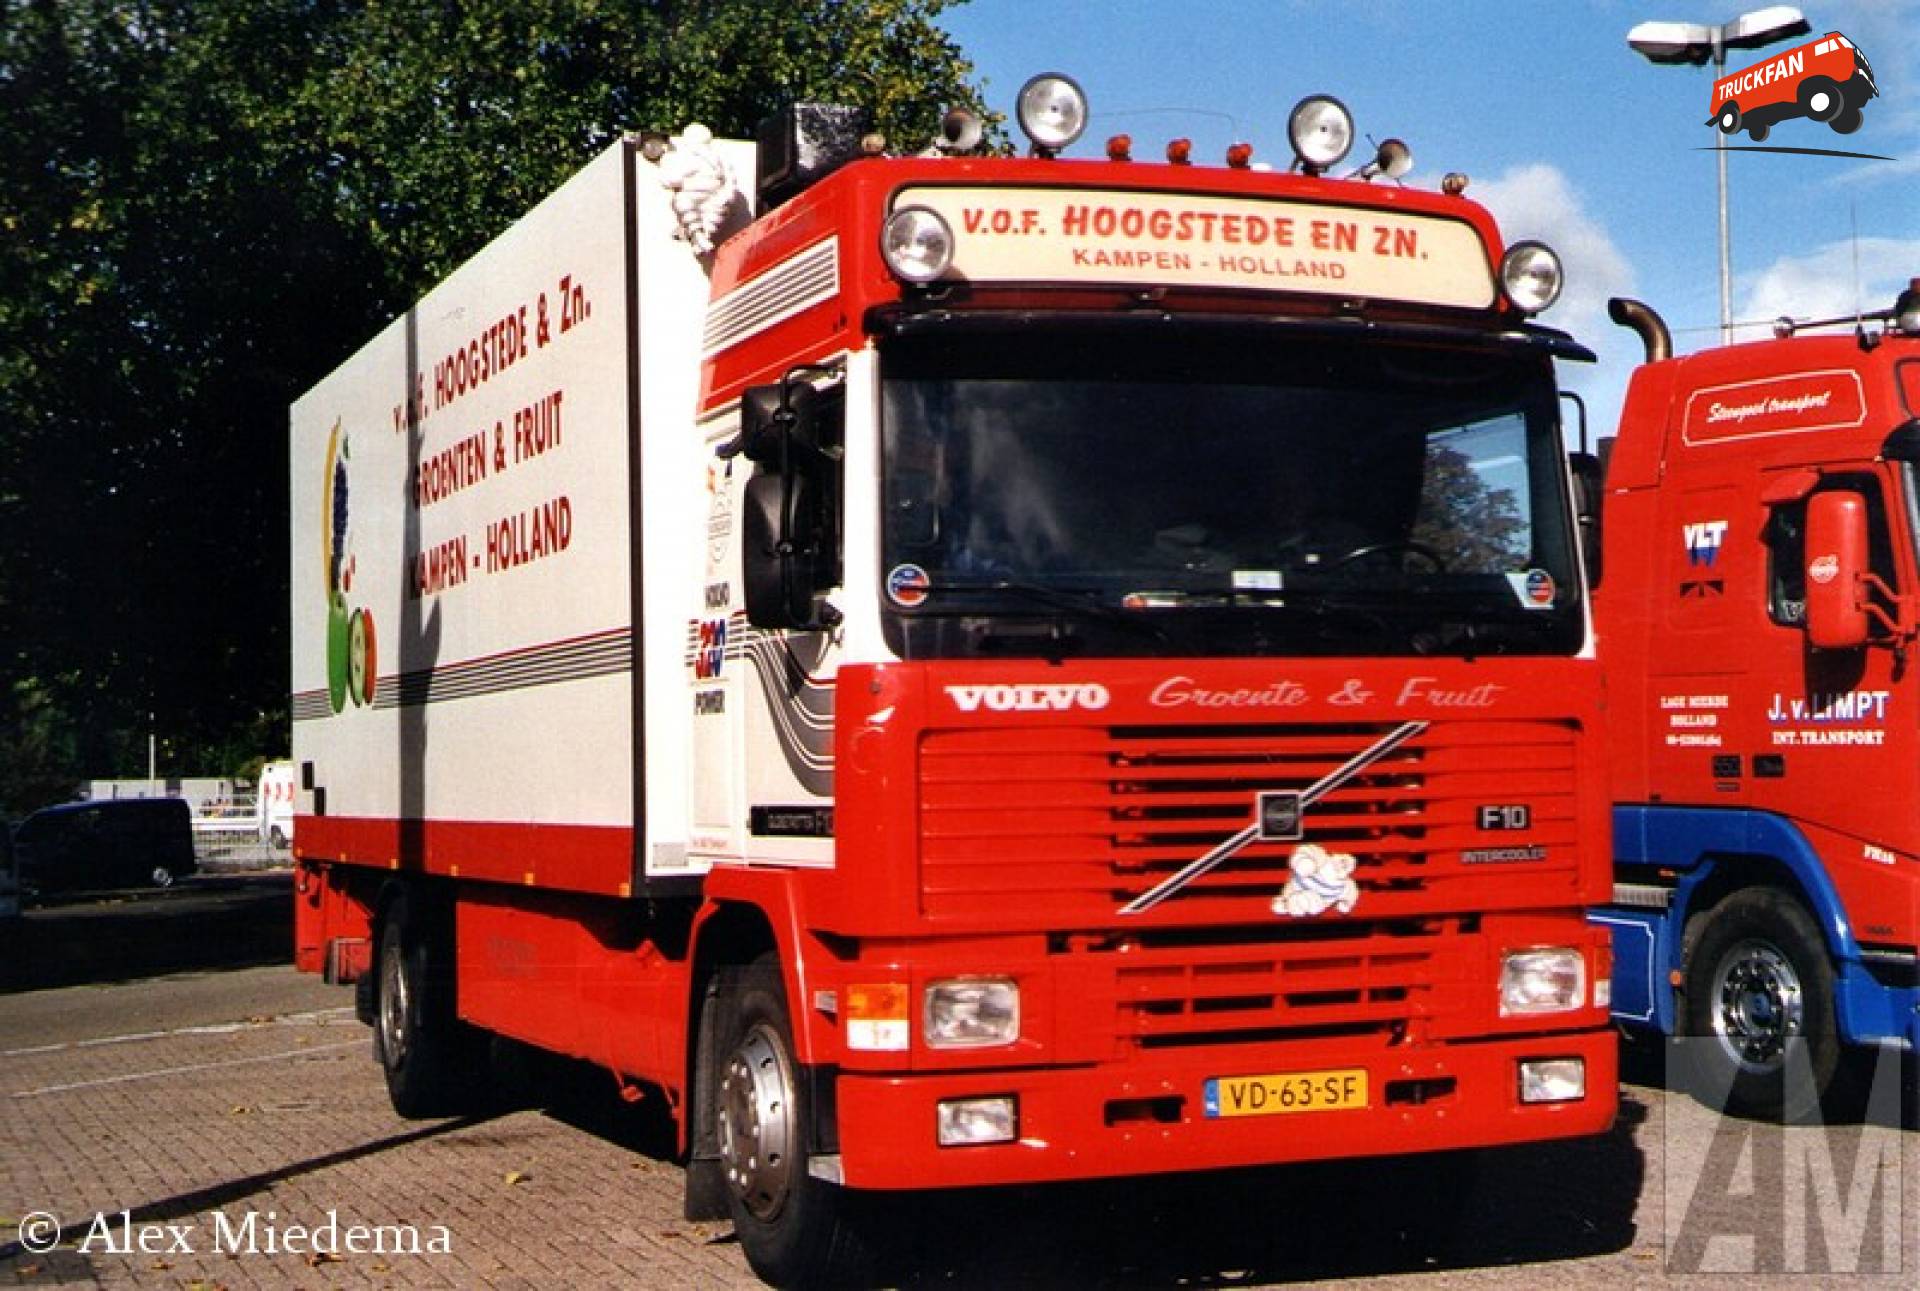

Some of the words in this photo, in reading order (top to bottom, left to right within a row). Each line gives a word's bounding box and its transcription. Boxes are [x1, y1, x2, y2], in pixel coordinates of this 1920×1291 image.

[962, 207, 1046, 235] V.O.F.
[1062, 204, 1295, 247] HOOGSTEDE
[1310, 220, 1358, 253] EN
[1373, 227, 1429, 260] ZN.
[1072, 248, 1191, 270] KAMPEN
[1218, 255, 1347, 279] HOLLAND
[434, 305, 527, 411] HOOGSTEDE
[537, 292, 550, 348] &
[558, 273, 591, 334] Zn.
[494, 421, 507, 473] &
[514, 390, 562, 464] FRUIT
[487, 496, 572, 574] HOLLAND
[944, 683, 1110, 711] VOLVO
[1151, 676, 1308, 707] Groente
[1326, 678, 1375, 707] &
[1396, 677, 1506, 707] Fruit
[1482, 805, 1527, 829] F10
[1229, 1077, 1357, 1110] VD-63-SF
